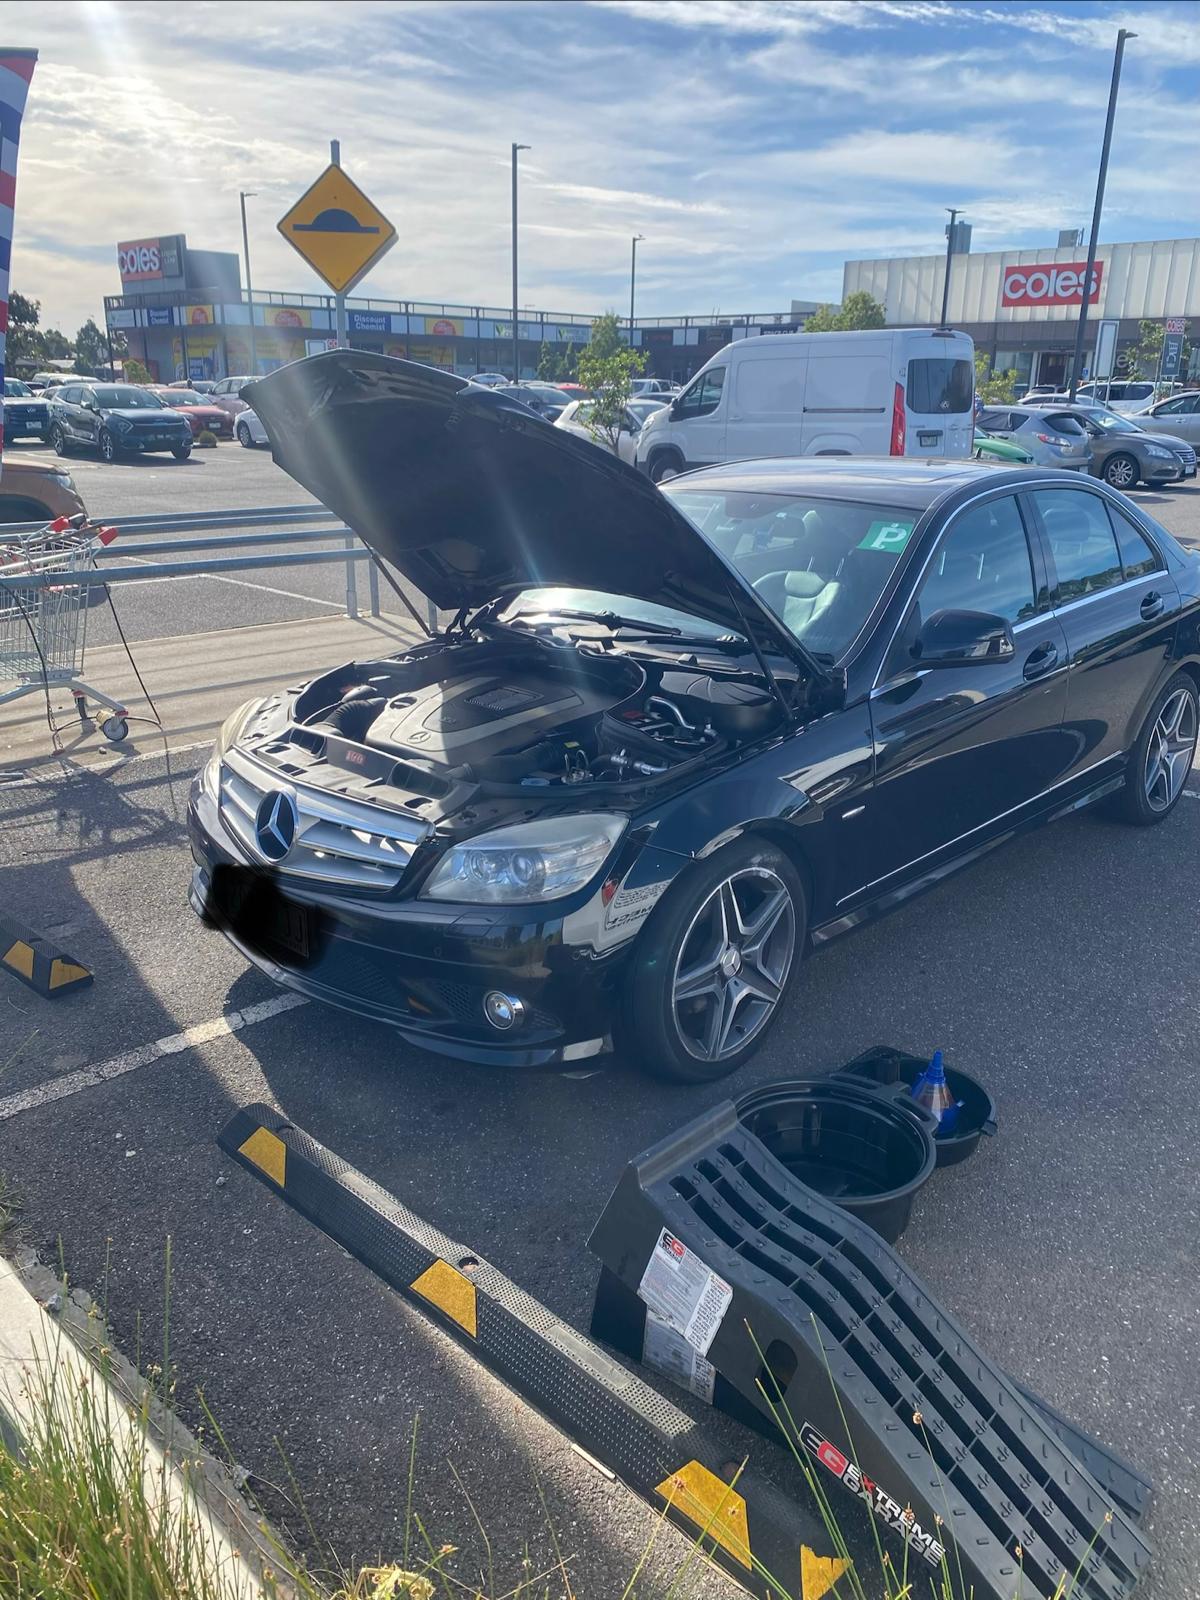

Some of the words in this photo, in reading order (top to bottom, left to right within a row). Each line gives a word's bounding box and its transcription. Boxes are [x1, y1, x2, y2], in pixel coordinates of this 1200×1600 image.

[118, 246, 160, 273] coles
[1004, 269, 1097, 299] coles
[354, 314, 386, 324] Discount
[355, 322, 386, 331] Chemist
[870, 526, 907, 549] P
[843, 1473, 943, 1567] GARAGE
[847, 1463, 946, 1557] EXTREME
